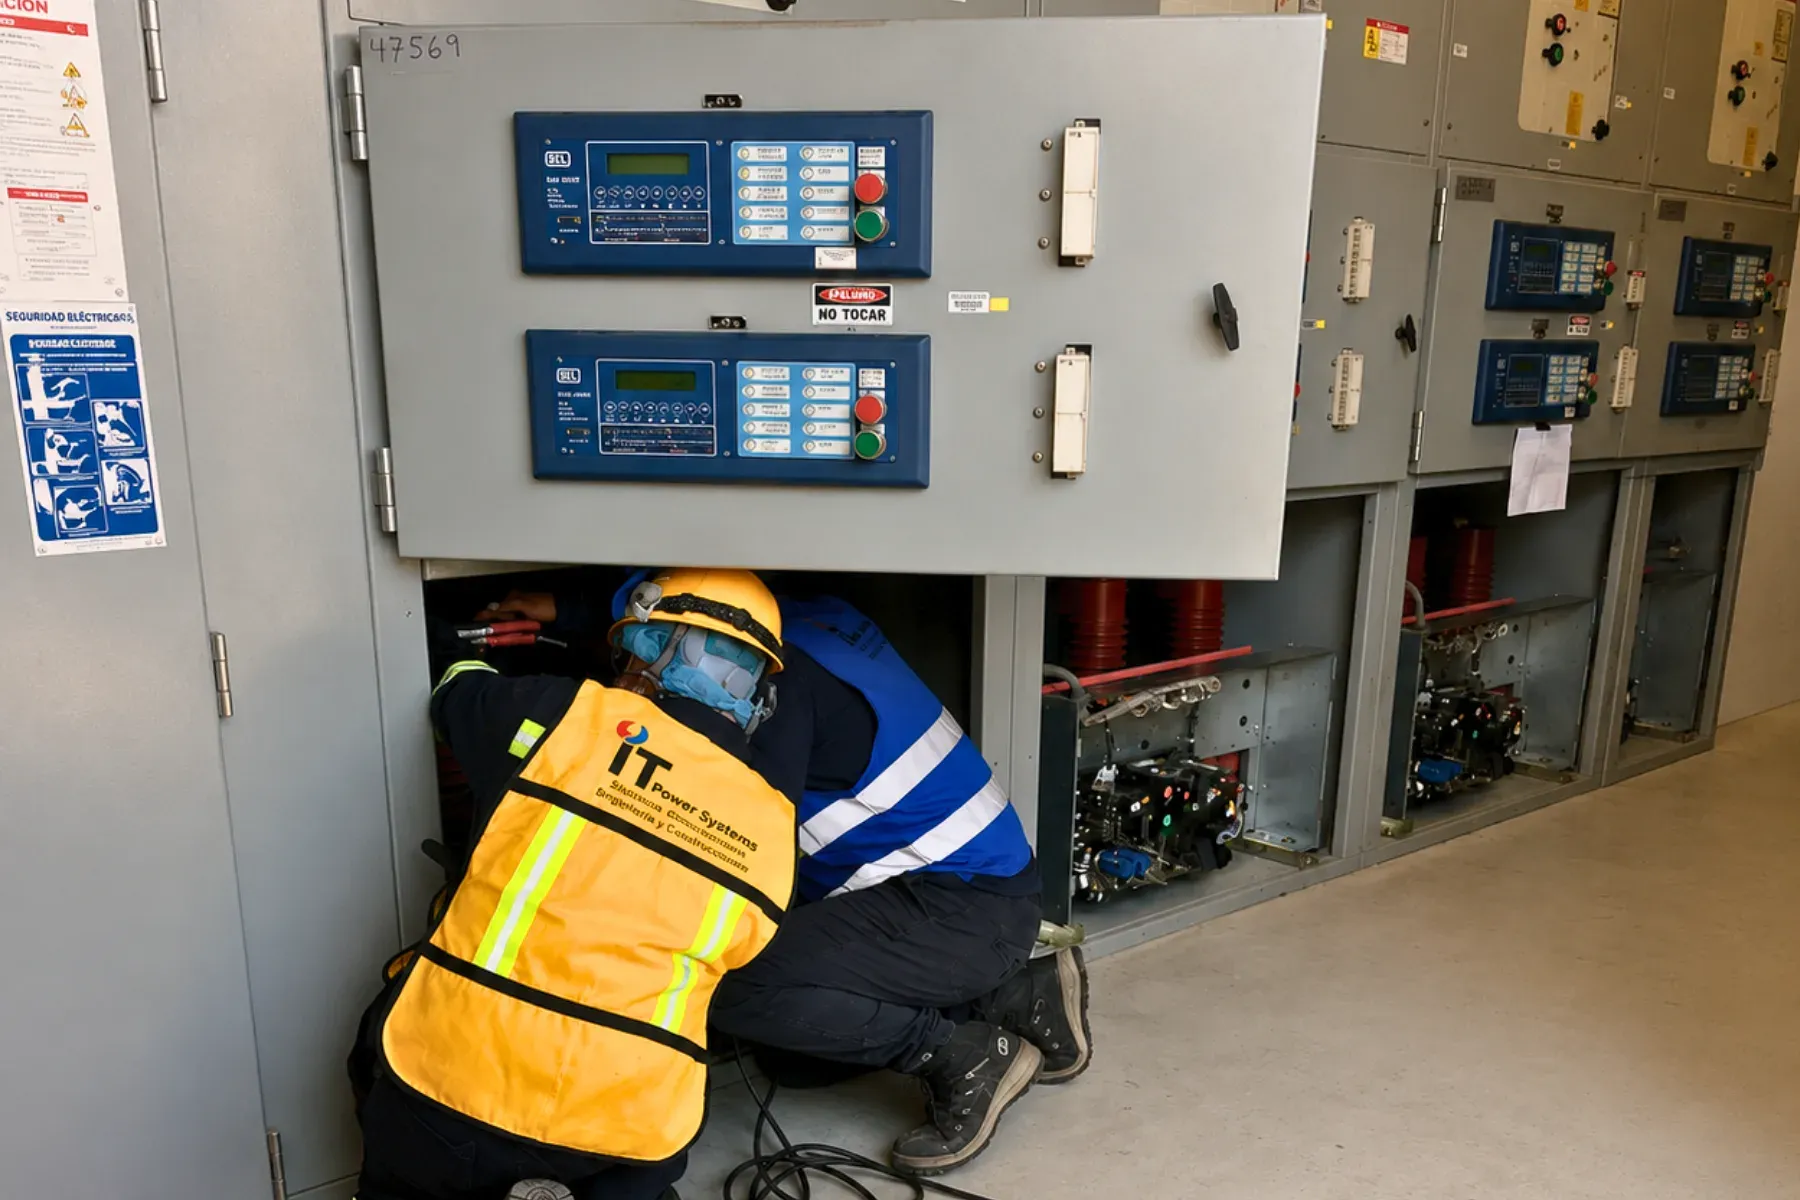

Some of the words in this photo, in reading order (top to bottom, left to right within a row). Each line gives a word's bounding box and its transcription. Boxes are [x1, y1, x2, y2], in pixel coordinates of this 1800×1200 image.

[370, 34, 460, 63] 47569
[5, 311, 65, 323] SEGURIDAD
[819, 308, 837, 320] NO
[842, 308, 887, 321] TOCAR
